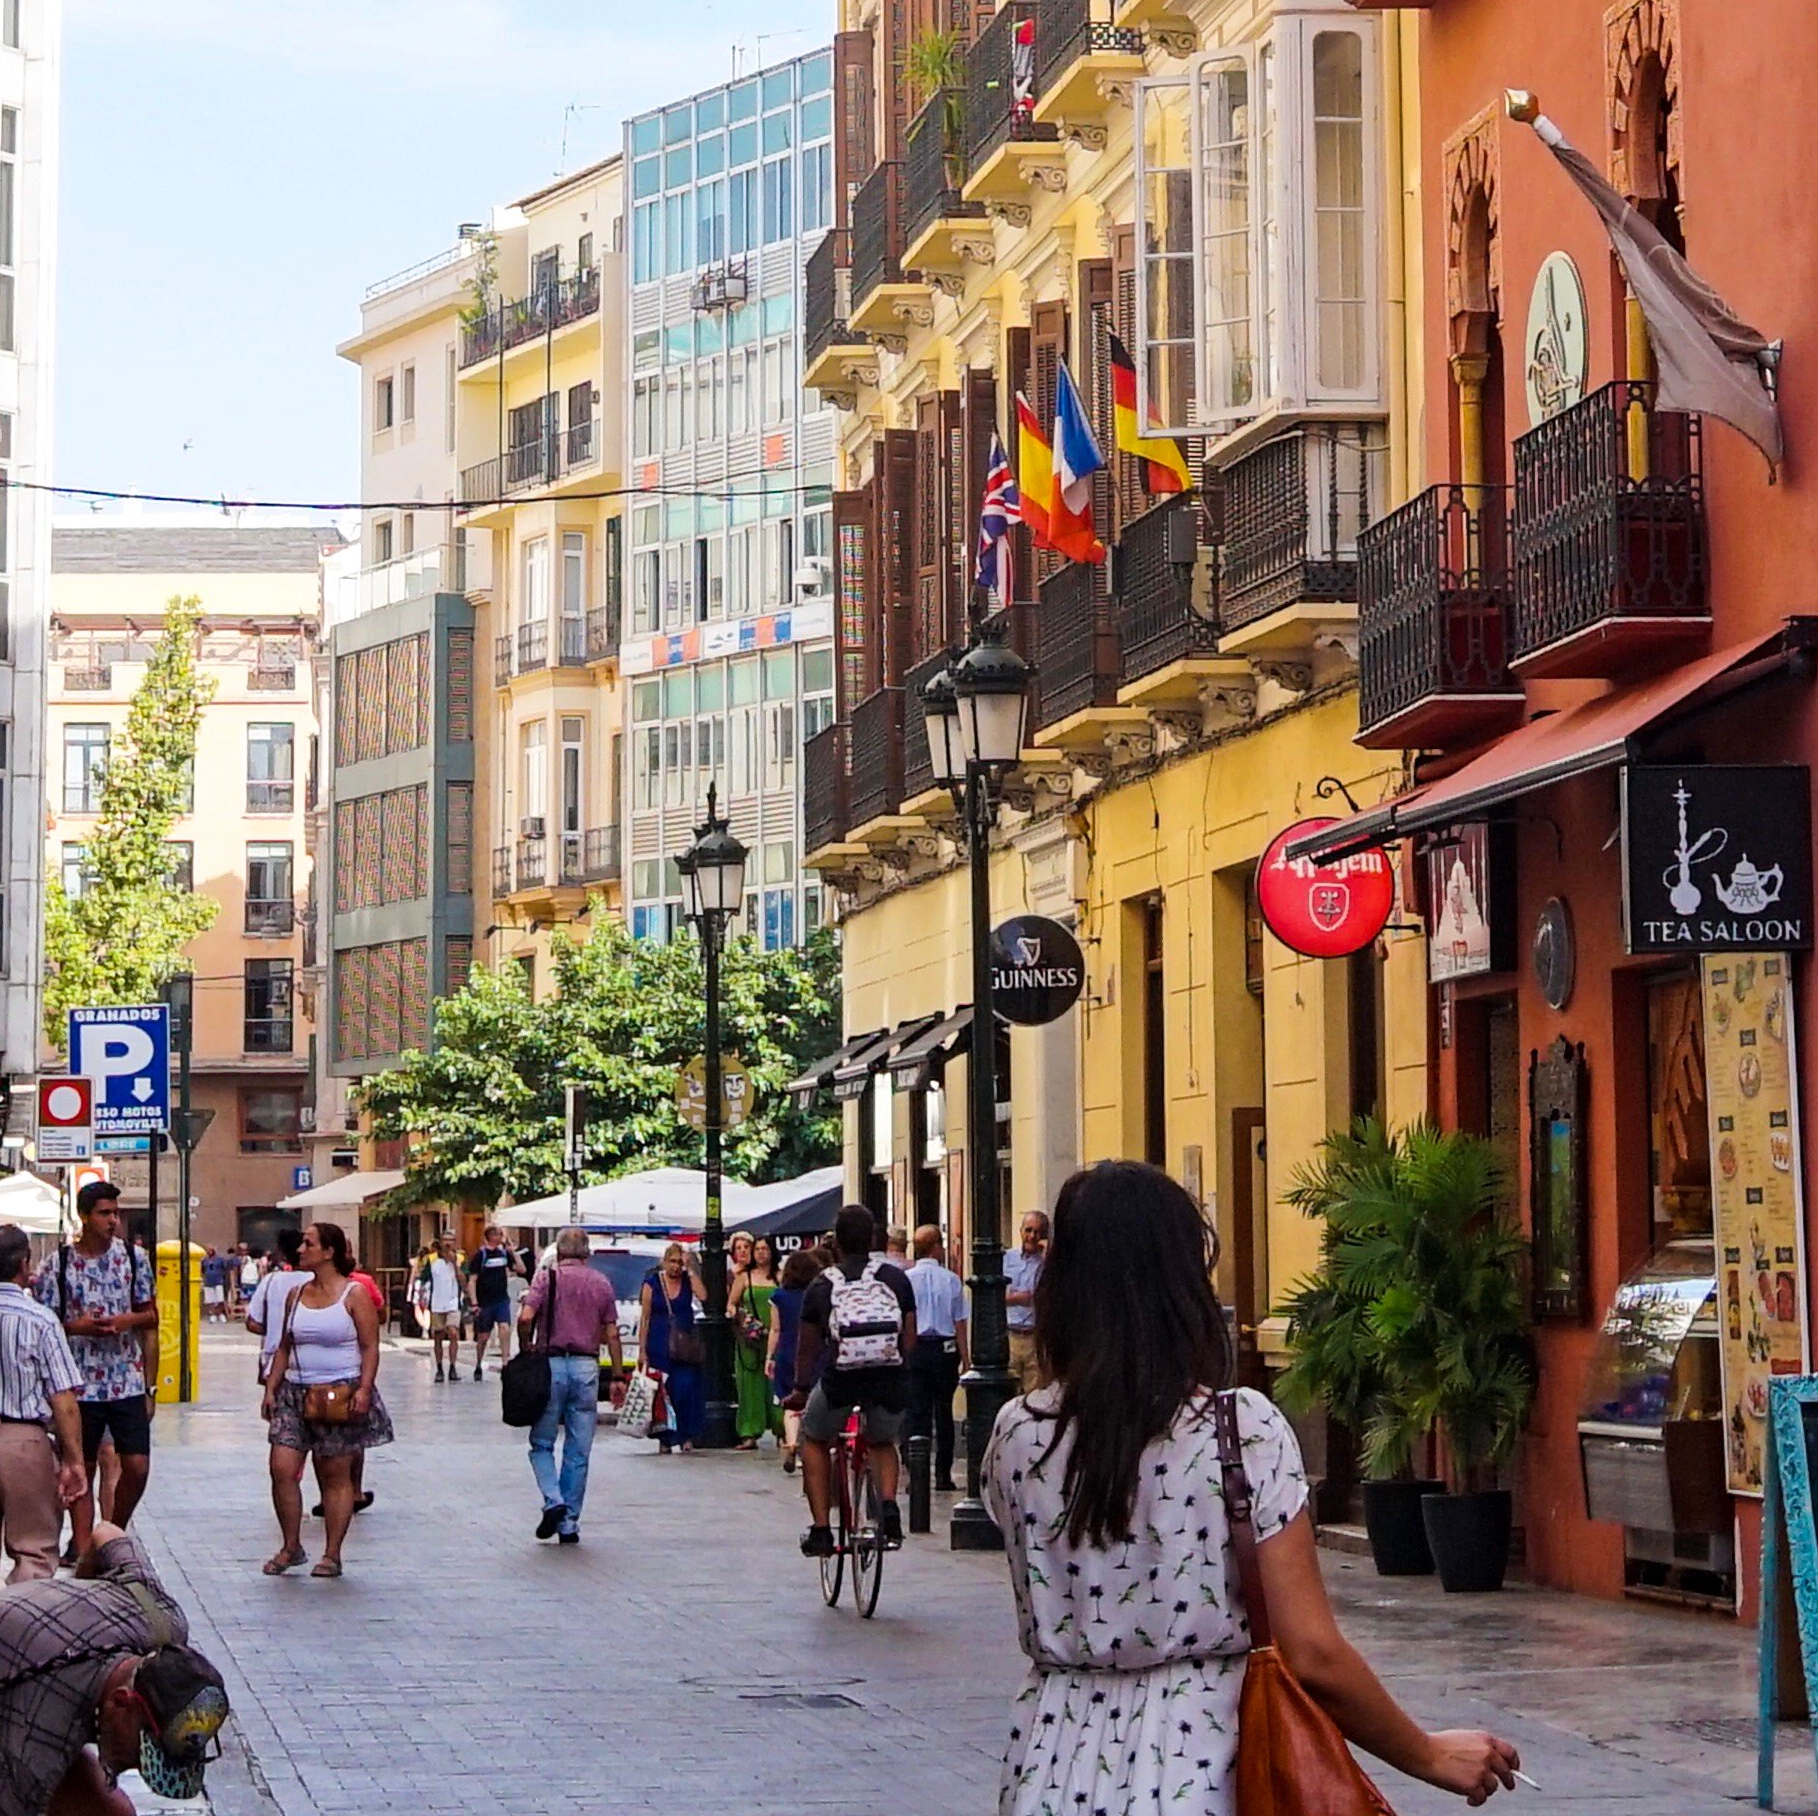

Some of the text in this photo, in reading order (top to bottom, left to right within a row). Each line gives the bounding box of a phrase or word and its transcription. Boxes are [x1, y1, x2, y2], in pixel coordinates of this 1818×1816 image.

[1642, 919, 1801, 943] TEA SALOON
[80, 1024, 155, 1104] P
[94, 1117, 165, 1130] UTOMOVILES
